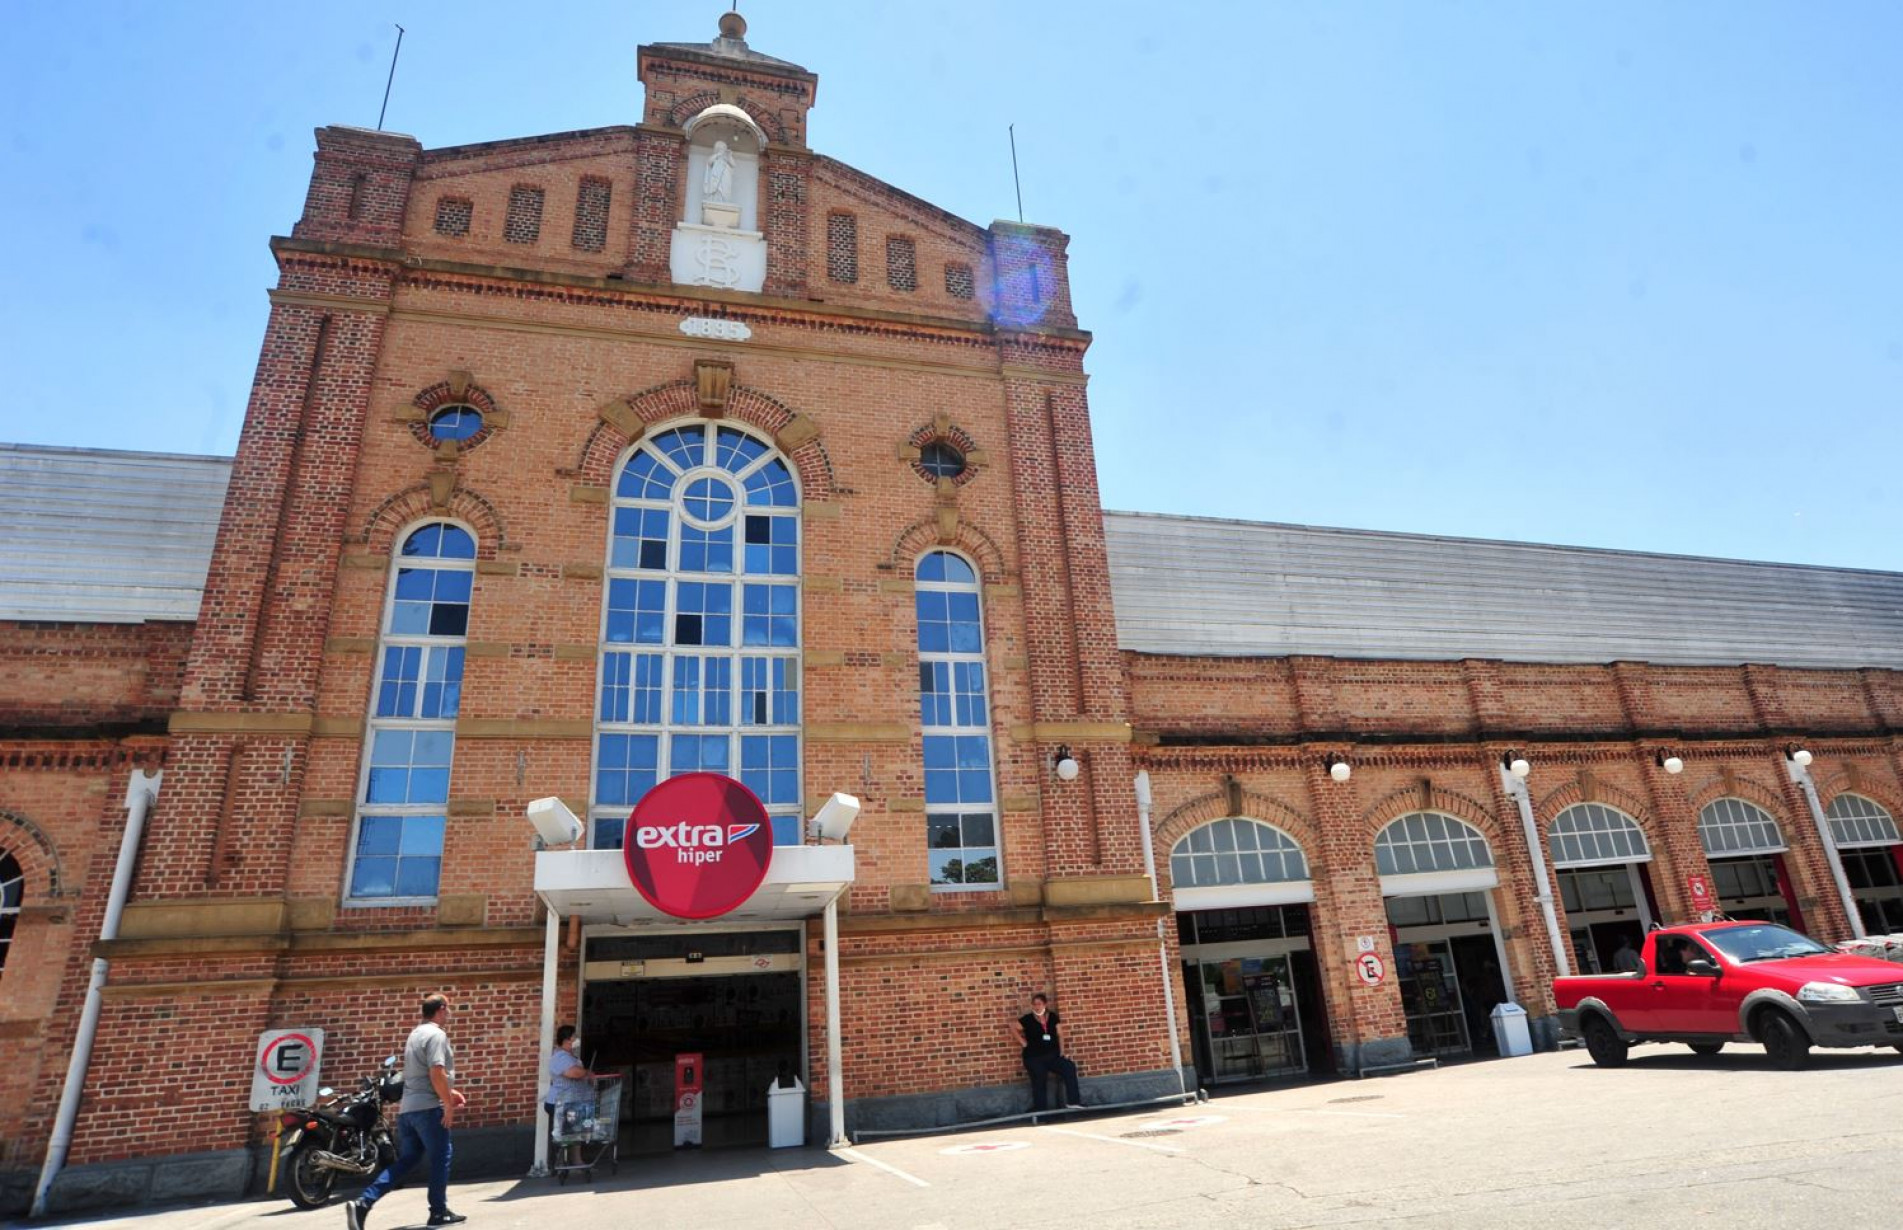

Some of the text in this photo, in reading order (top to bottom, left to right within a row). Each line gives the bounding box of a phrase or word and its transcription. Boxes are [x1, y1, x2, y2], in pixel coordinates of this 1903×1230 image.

[690, 319, 738, 338] 1895
[637, 821, 723, 849] extra
[677, 848, 723, 867] hiper
[276, 1043, 304, 1072] E
[271, 1084, 299, 1096] TAXI
